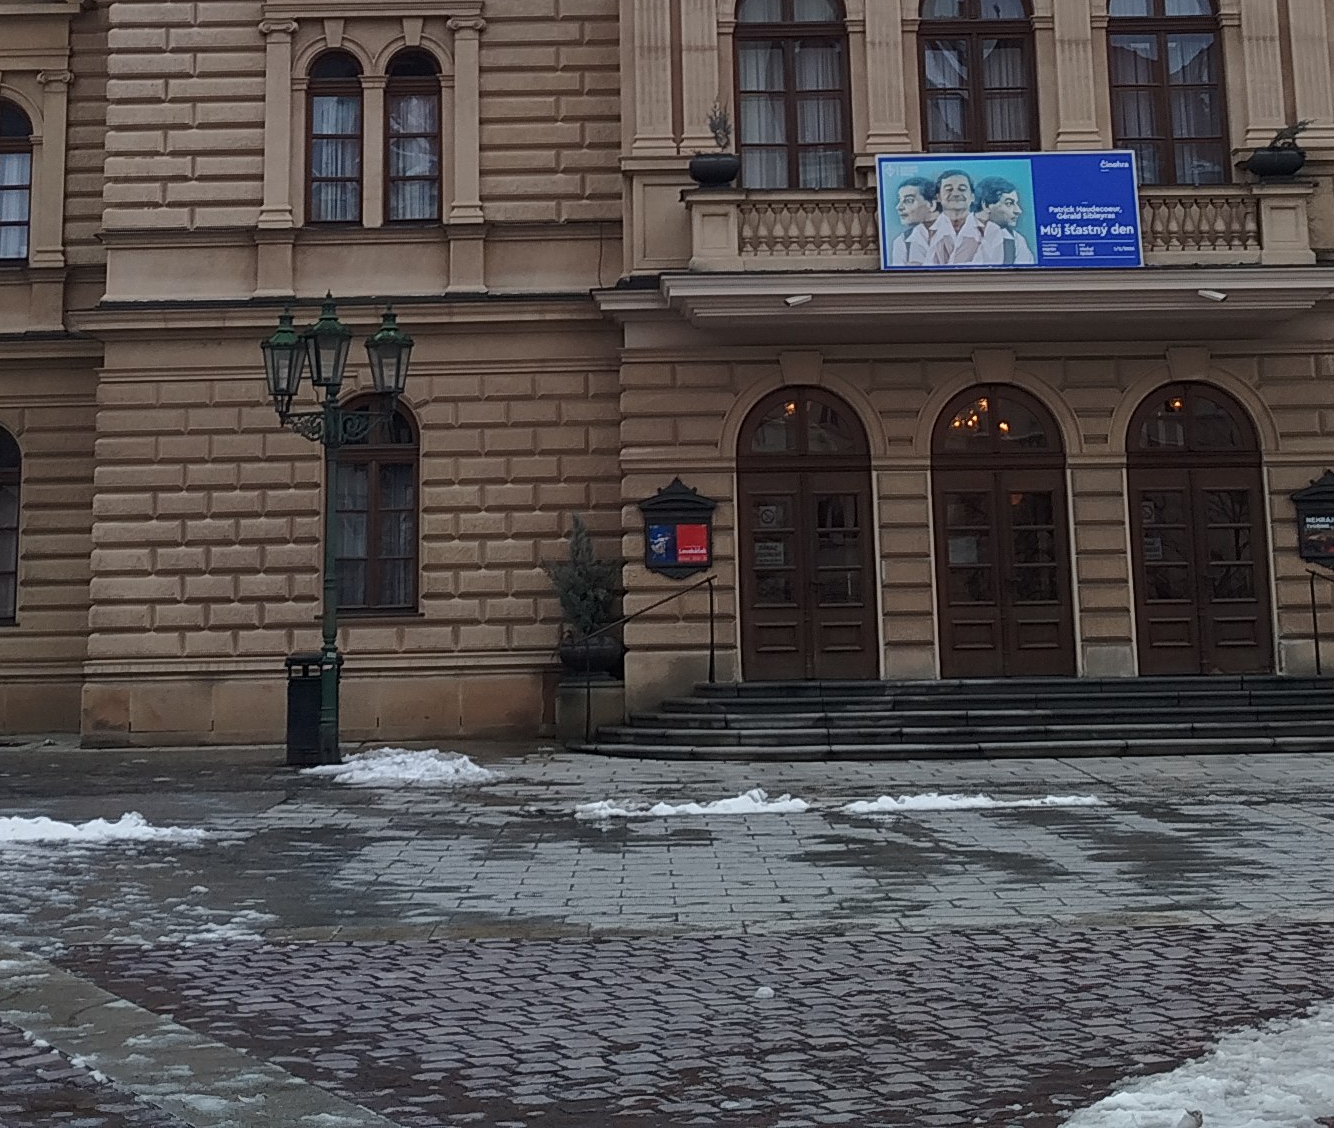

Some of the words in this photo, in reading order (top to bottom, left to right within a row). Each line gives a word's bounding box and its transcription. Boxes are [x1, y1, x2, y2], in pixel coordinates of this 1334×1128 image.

[1040, 223, 1062, 238] Můj
[1064, 222, 1108, 237] šťastný
[1110, 222, 1135, 235] den
